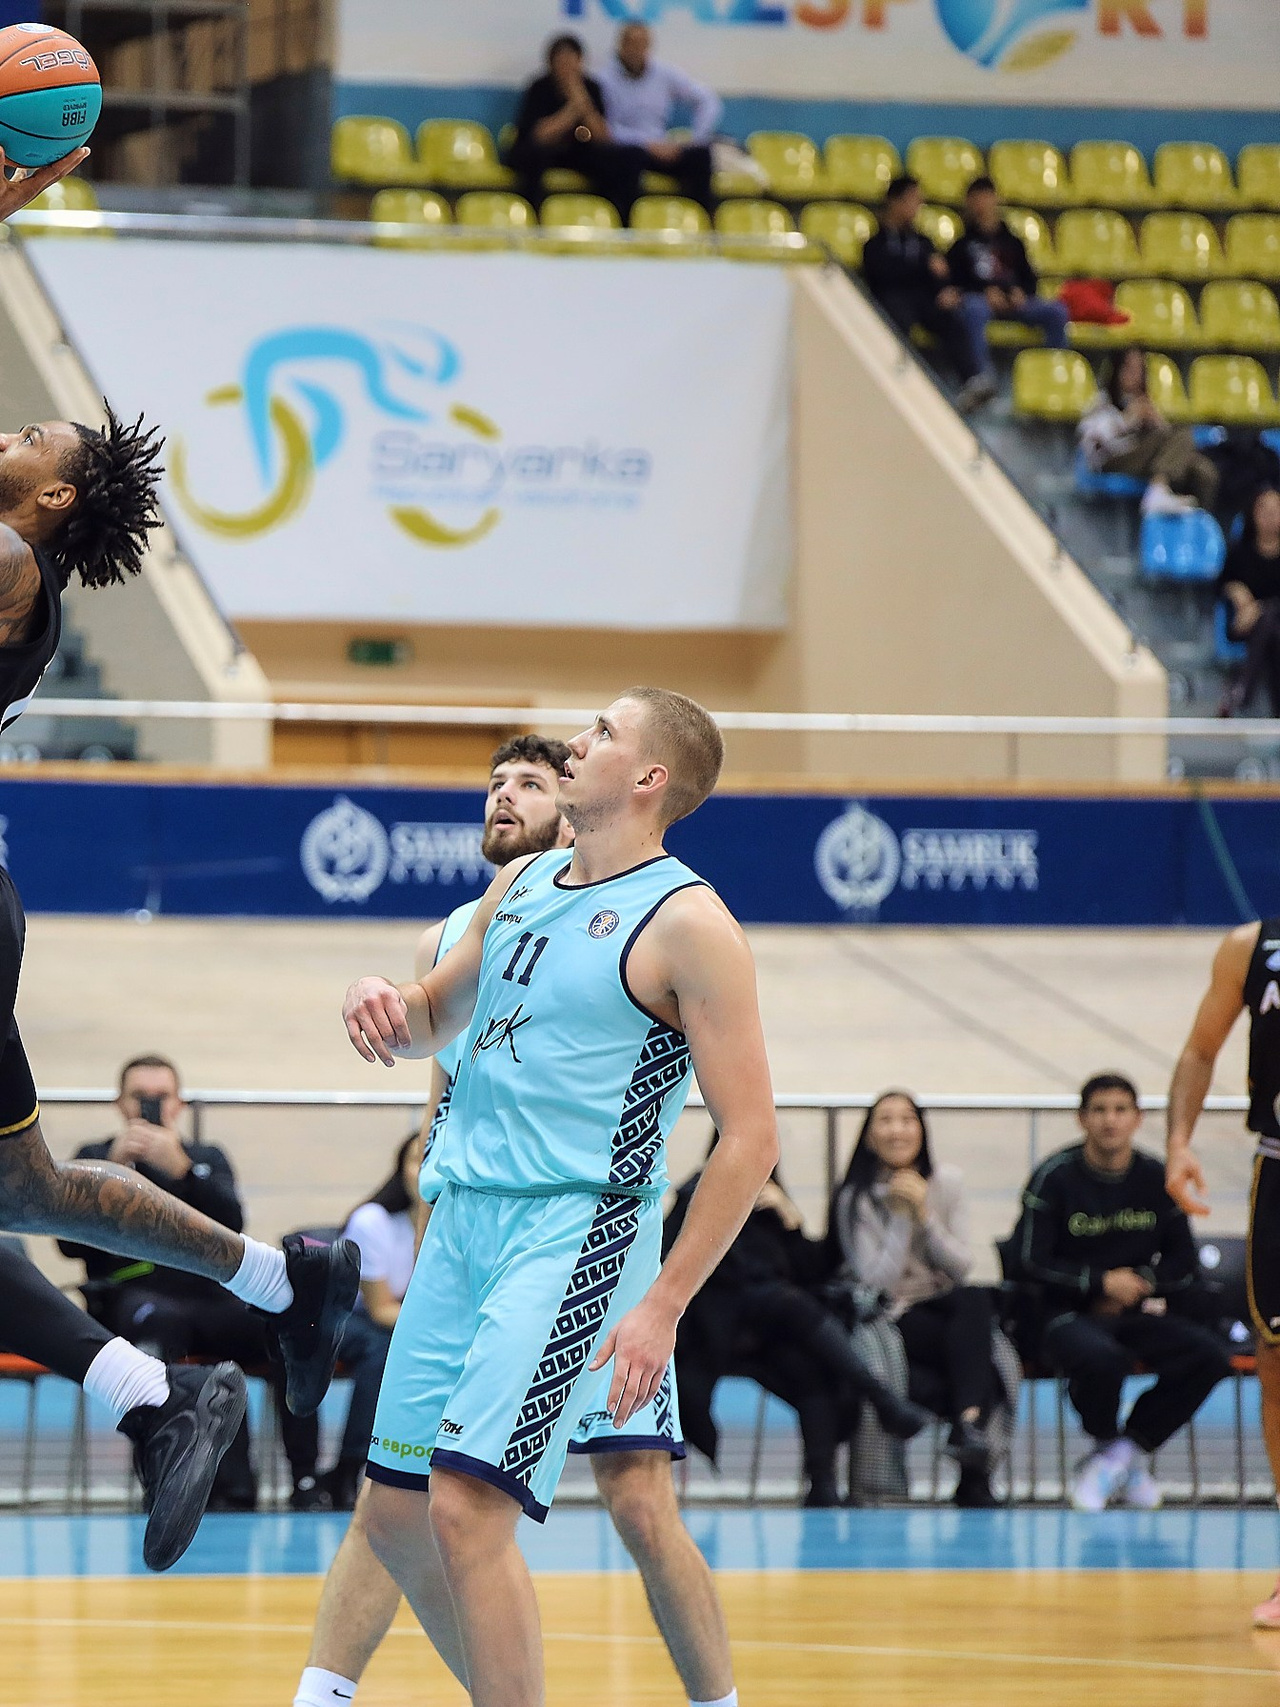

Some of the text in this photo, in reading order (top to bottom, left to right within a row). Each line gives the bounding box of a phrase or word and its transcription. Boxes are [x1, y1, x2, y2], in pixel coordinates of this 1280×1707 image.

[20, 49, 91, 72] ÖGEL
[61, 109, 87, 127] FIBA
[502, 931, 550, 987] 11
